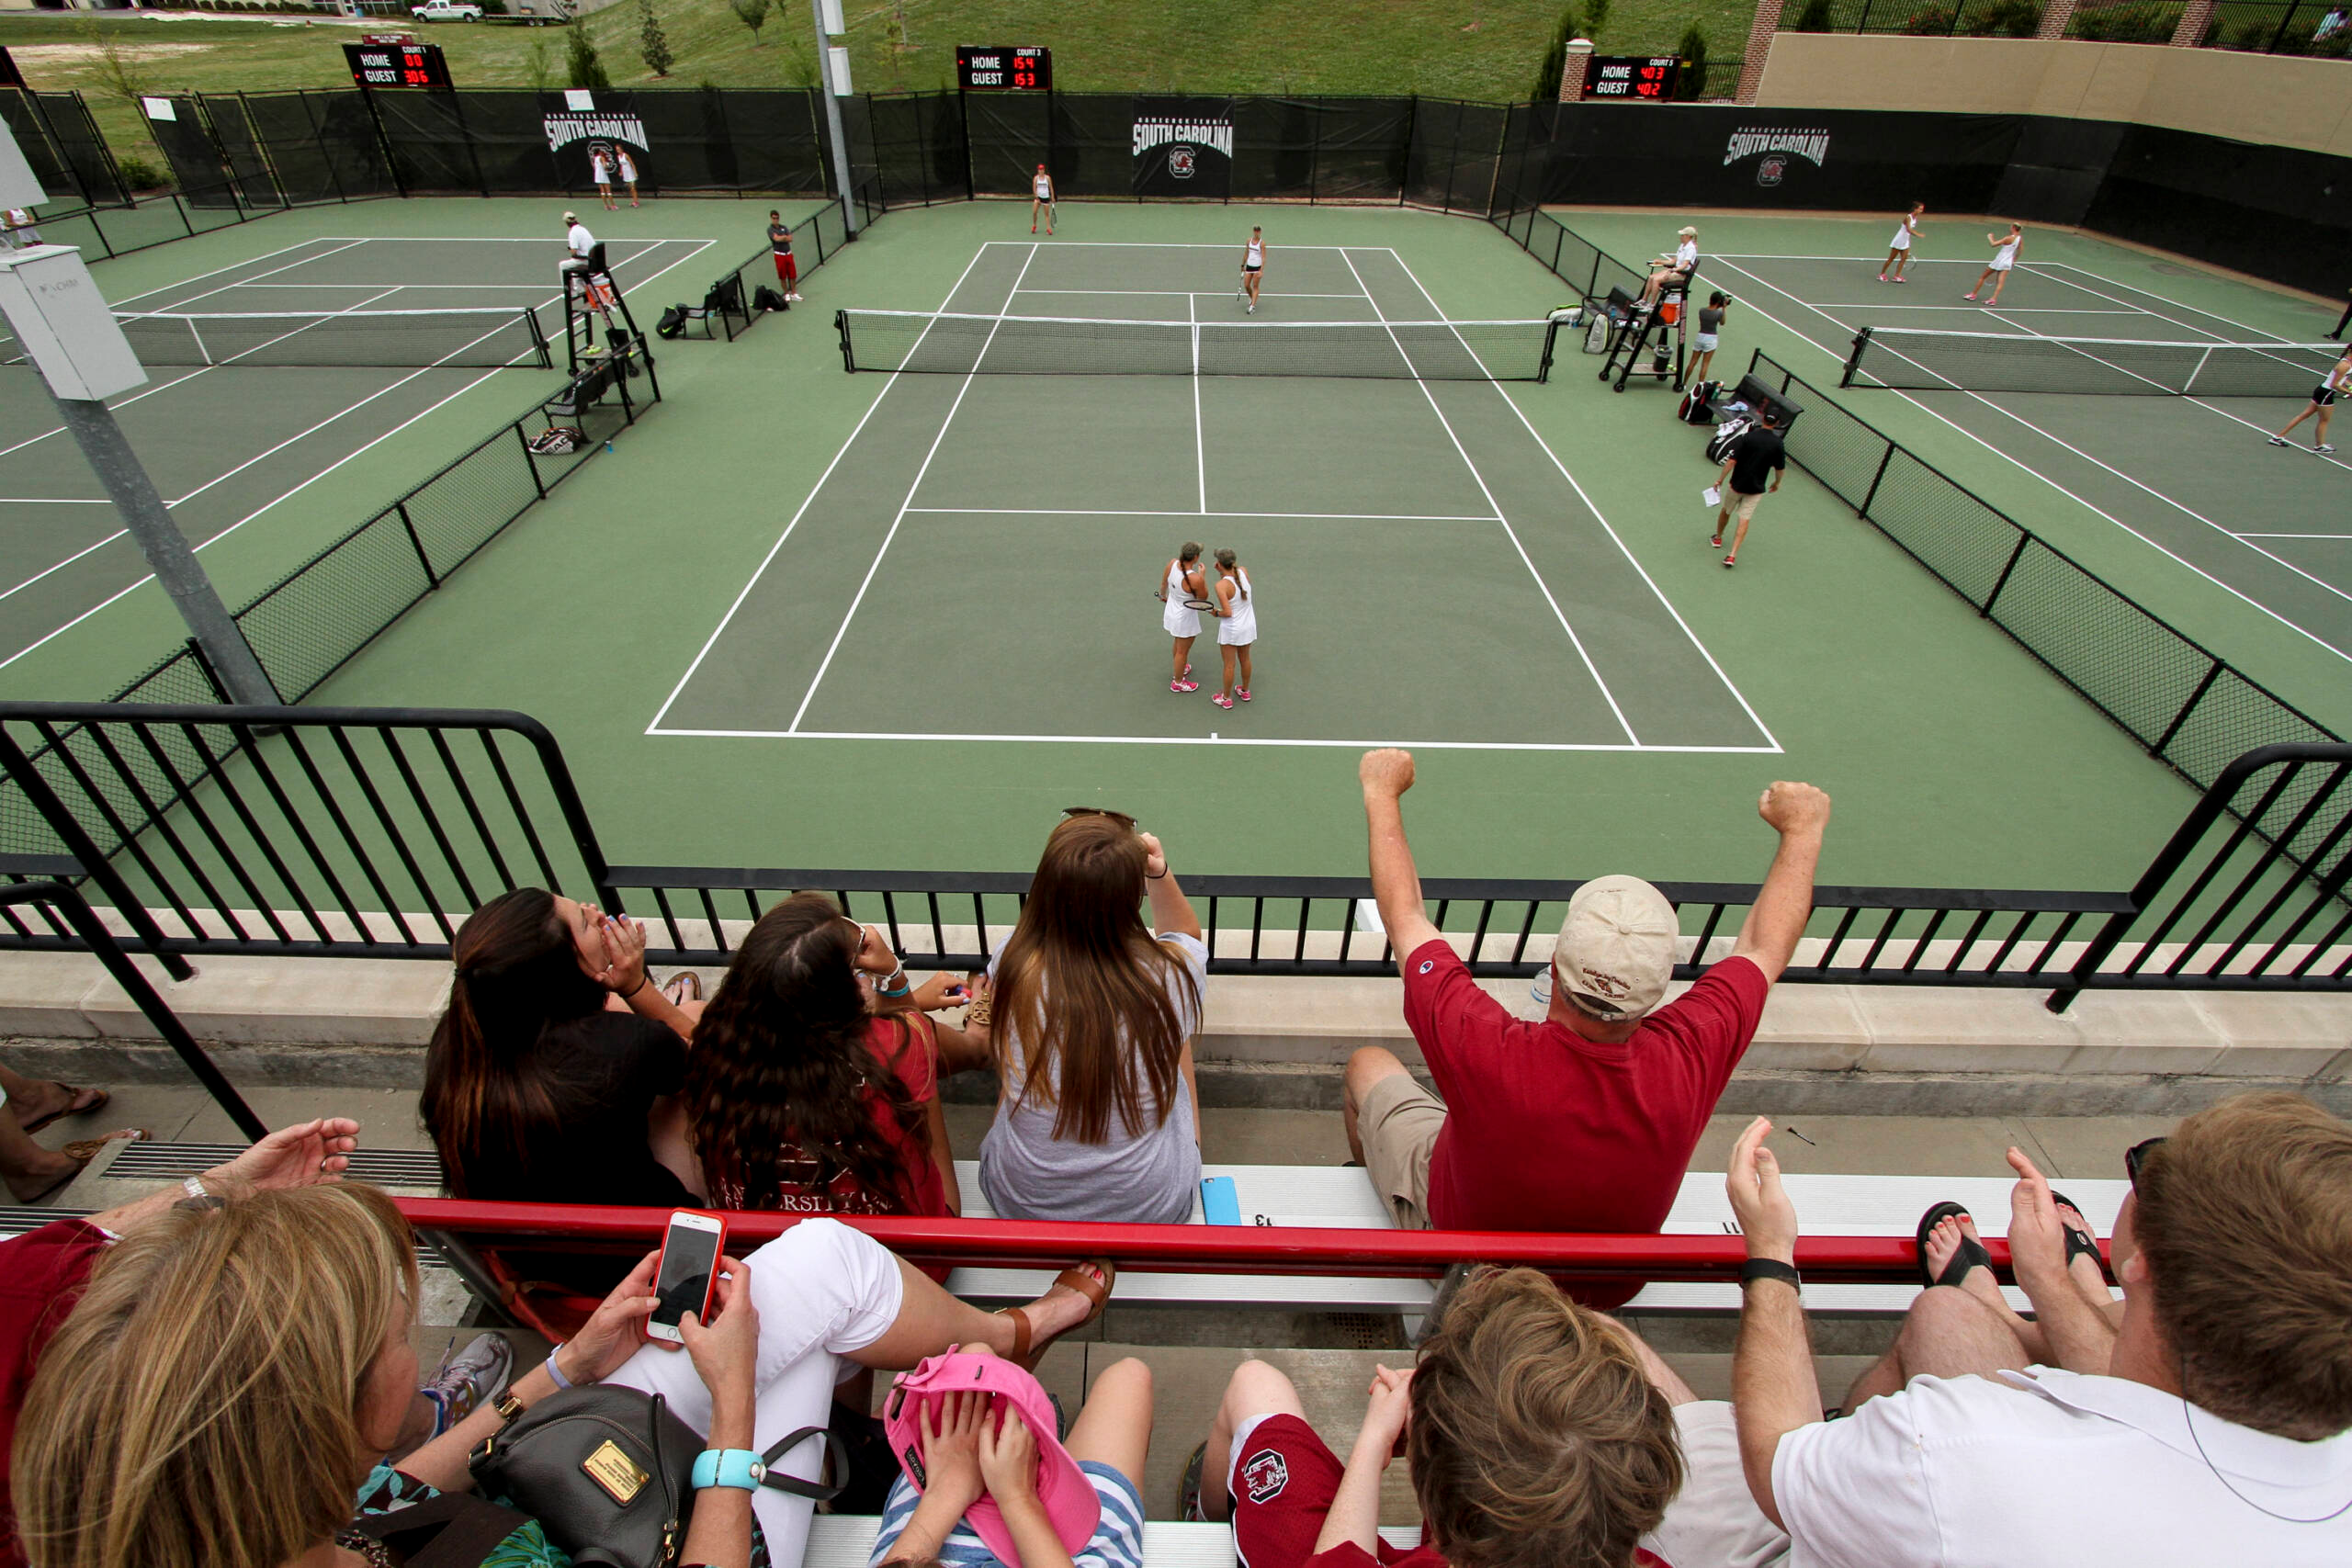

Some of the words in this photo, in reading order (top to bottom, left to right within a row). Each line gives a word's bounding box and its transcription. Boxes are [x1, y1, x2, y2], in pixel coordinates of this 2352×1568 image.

[360, 55, 391, 66] HOME
[971, 57, 1001, 69] HOME
[365, 70, 397, 82] GUEST
[1601, 66, 1632, 78] HOME
[971, 73, 1002, 85] GUEST
[1597, 82, 1630, 94] GUEST
[544, 119, 587, 152] SOUTH
[585, 119, 650, 153] CAROLINA
[1133, 123, 1173, 156] SOUTH
[1175, 124, 1233, 159] CAROLINA
[1724, 133, 1771, 166] SOUTH
[1769, 134, 1830, 167] CAROLINA
[1255, 1213, 1272, 1226] 13
